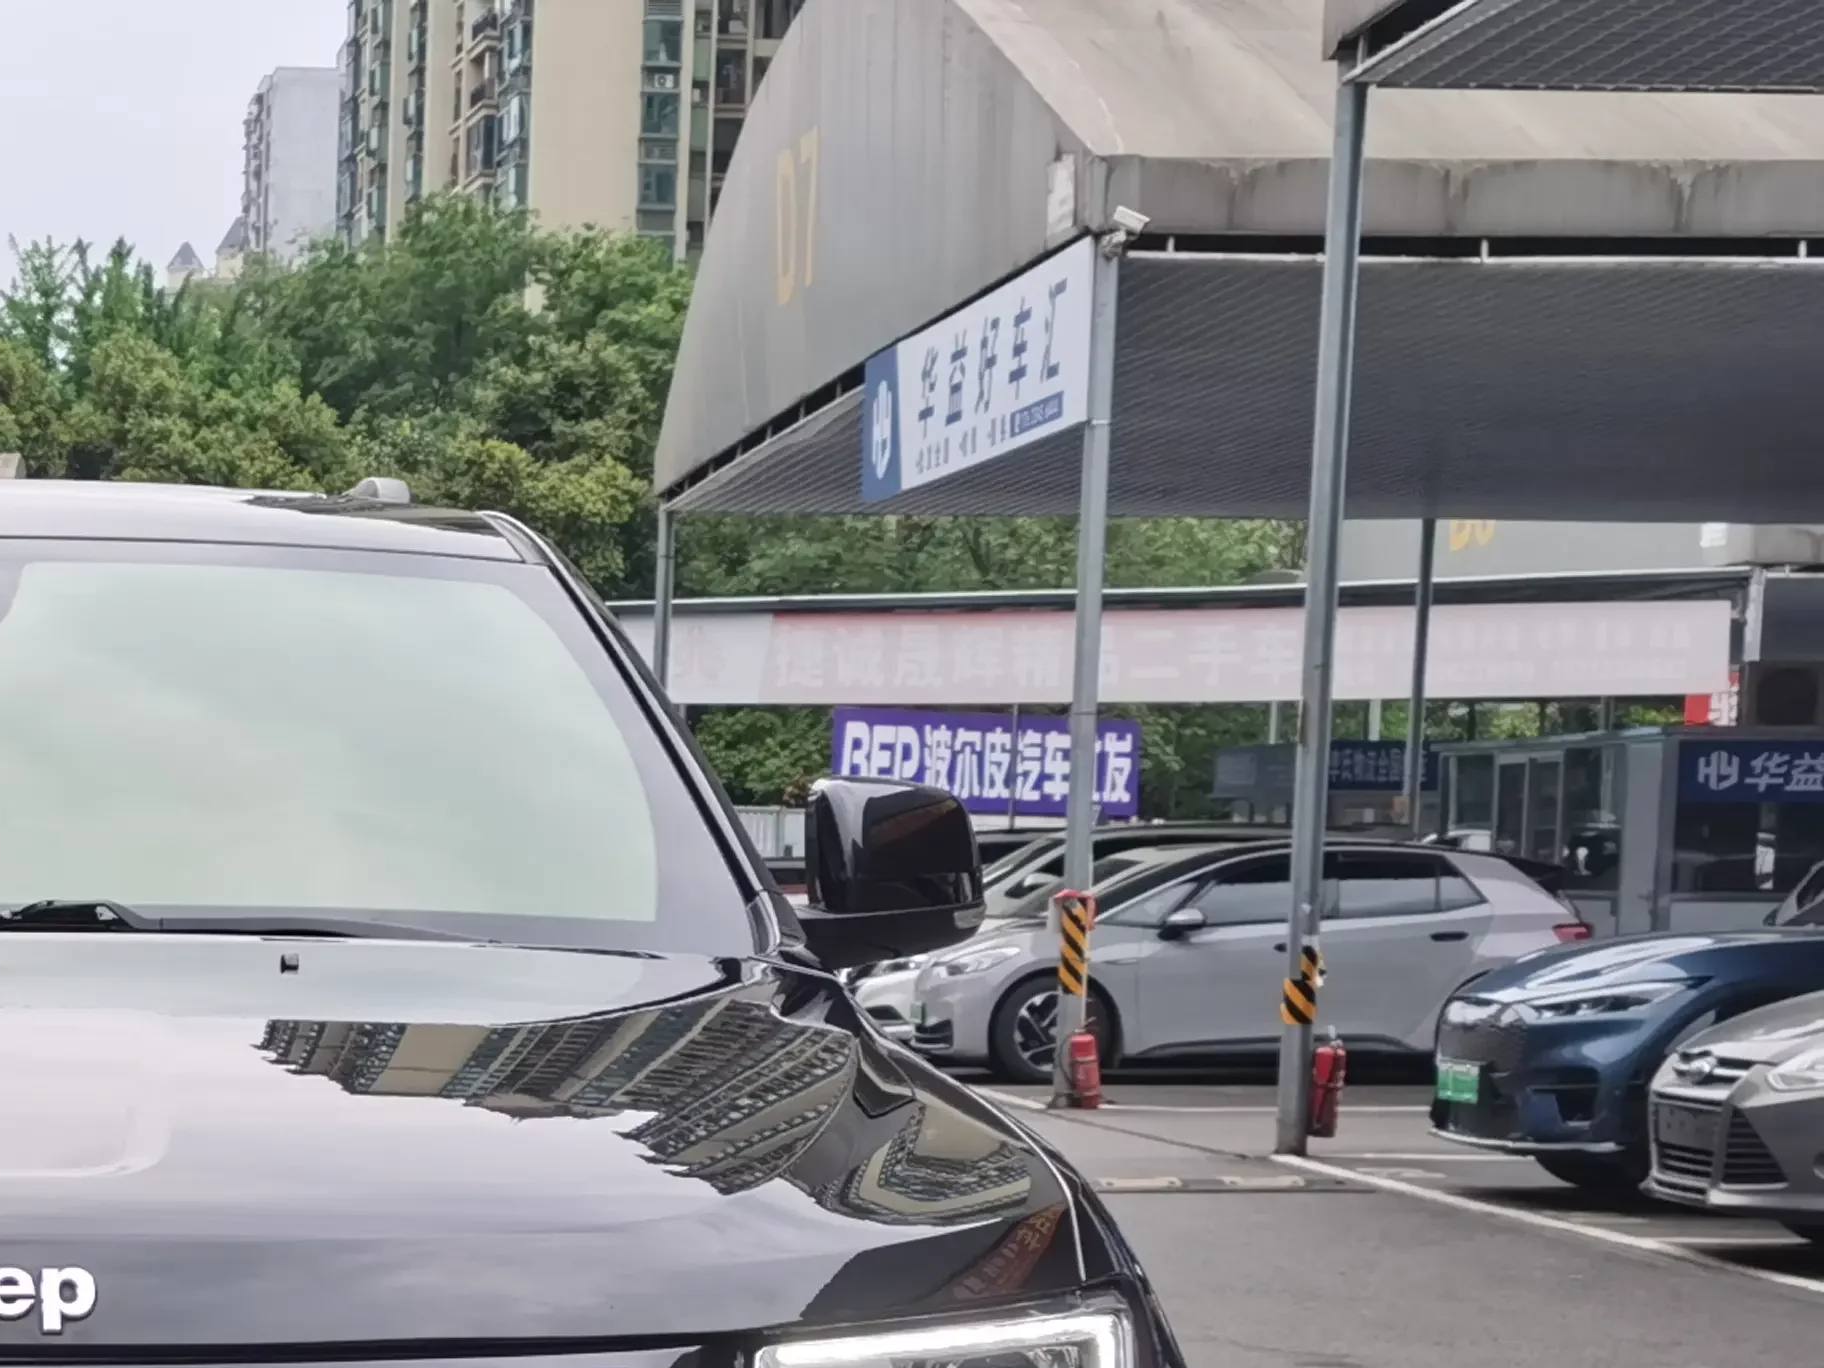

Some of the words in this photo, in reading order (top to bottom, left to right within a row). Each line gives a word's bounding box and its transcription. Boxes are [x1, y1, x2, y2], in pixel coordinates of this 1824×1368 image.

[917, 276, 1069, 440] 华益好车汇
